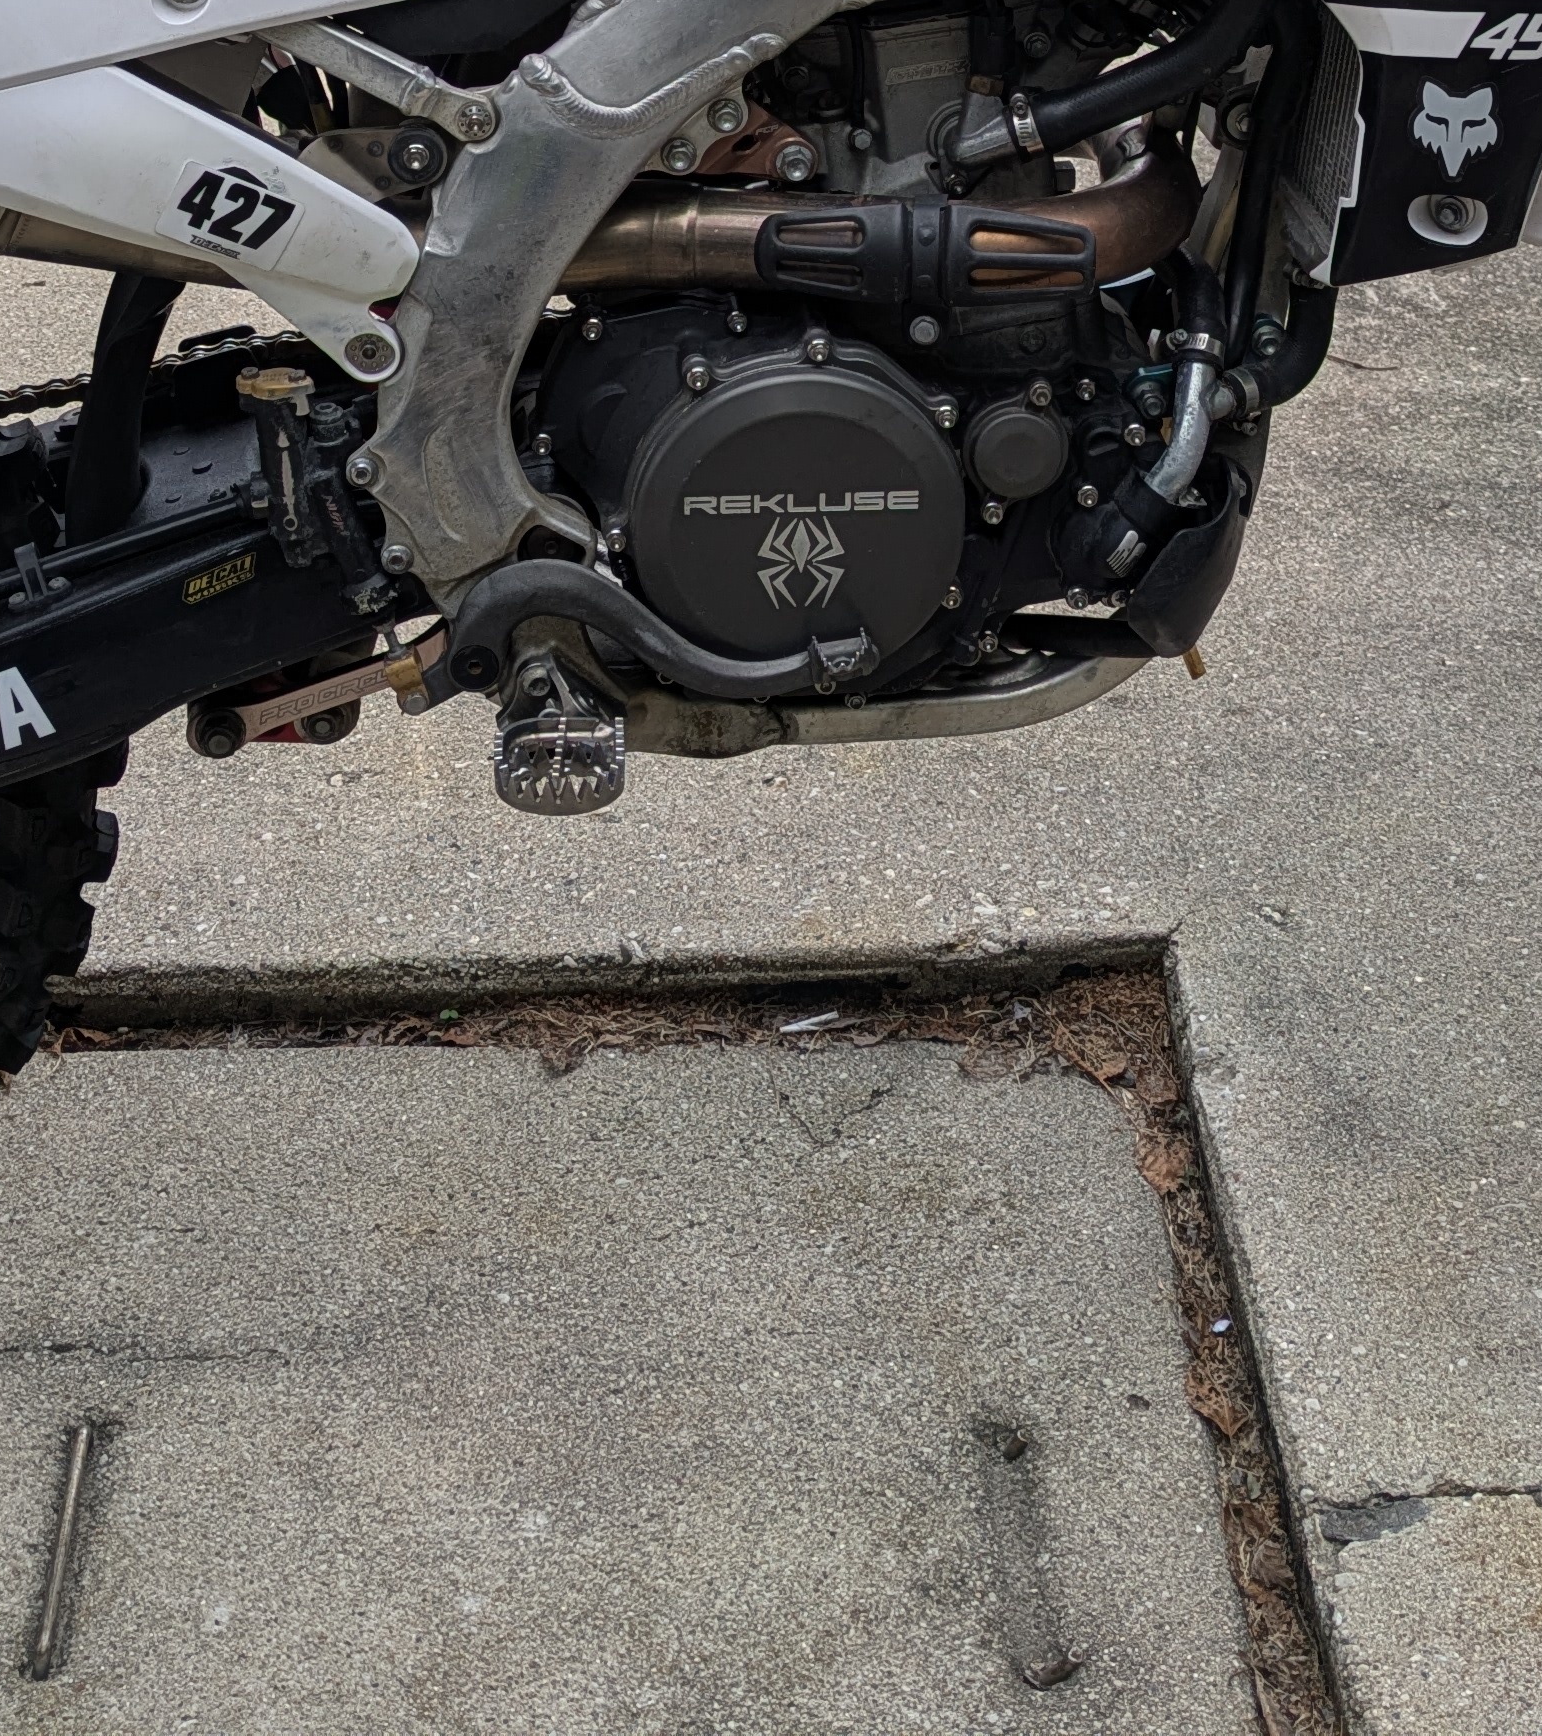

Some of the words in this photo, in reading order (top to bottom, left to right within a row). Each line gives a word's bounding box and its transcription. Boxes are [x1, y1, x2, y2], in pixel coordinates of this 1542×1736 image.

[177, 170, 297, 251] 427
[683, 489, 920, 516] REKLUSE
[260, 693, 316, 726] PRO
